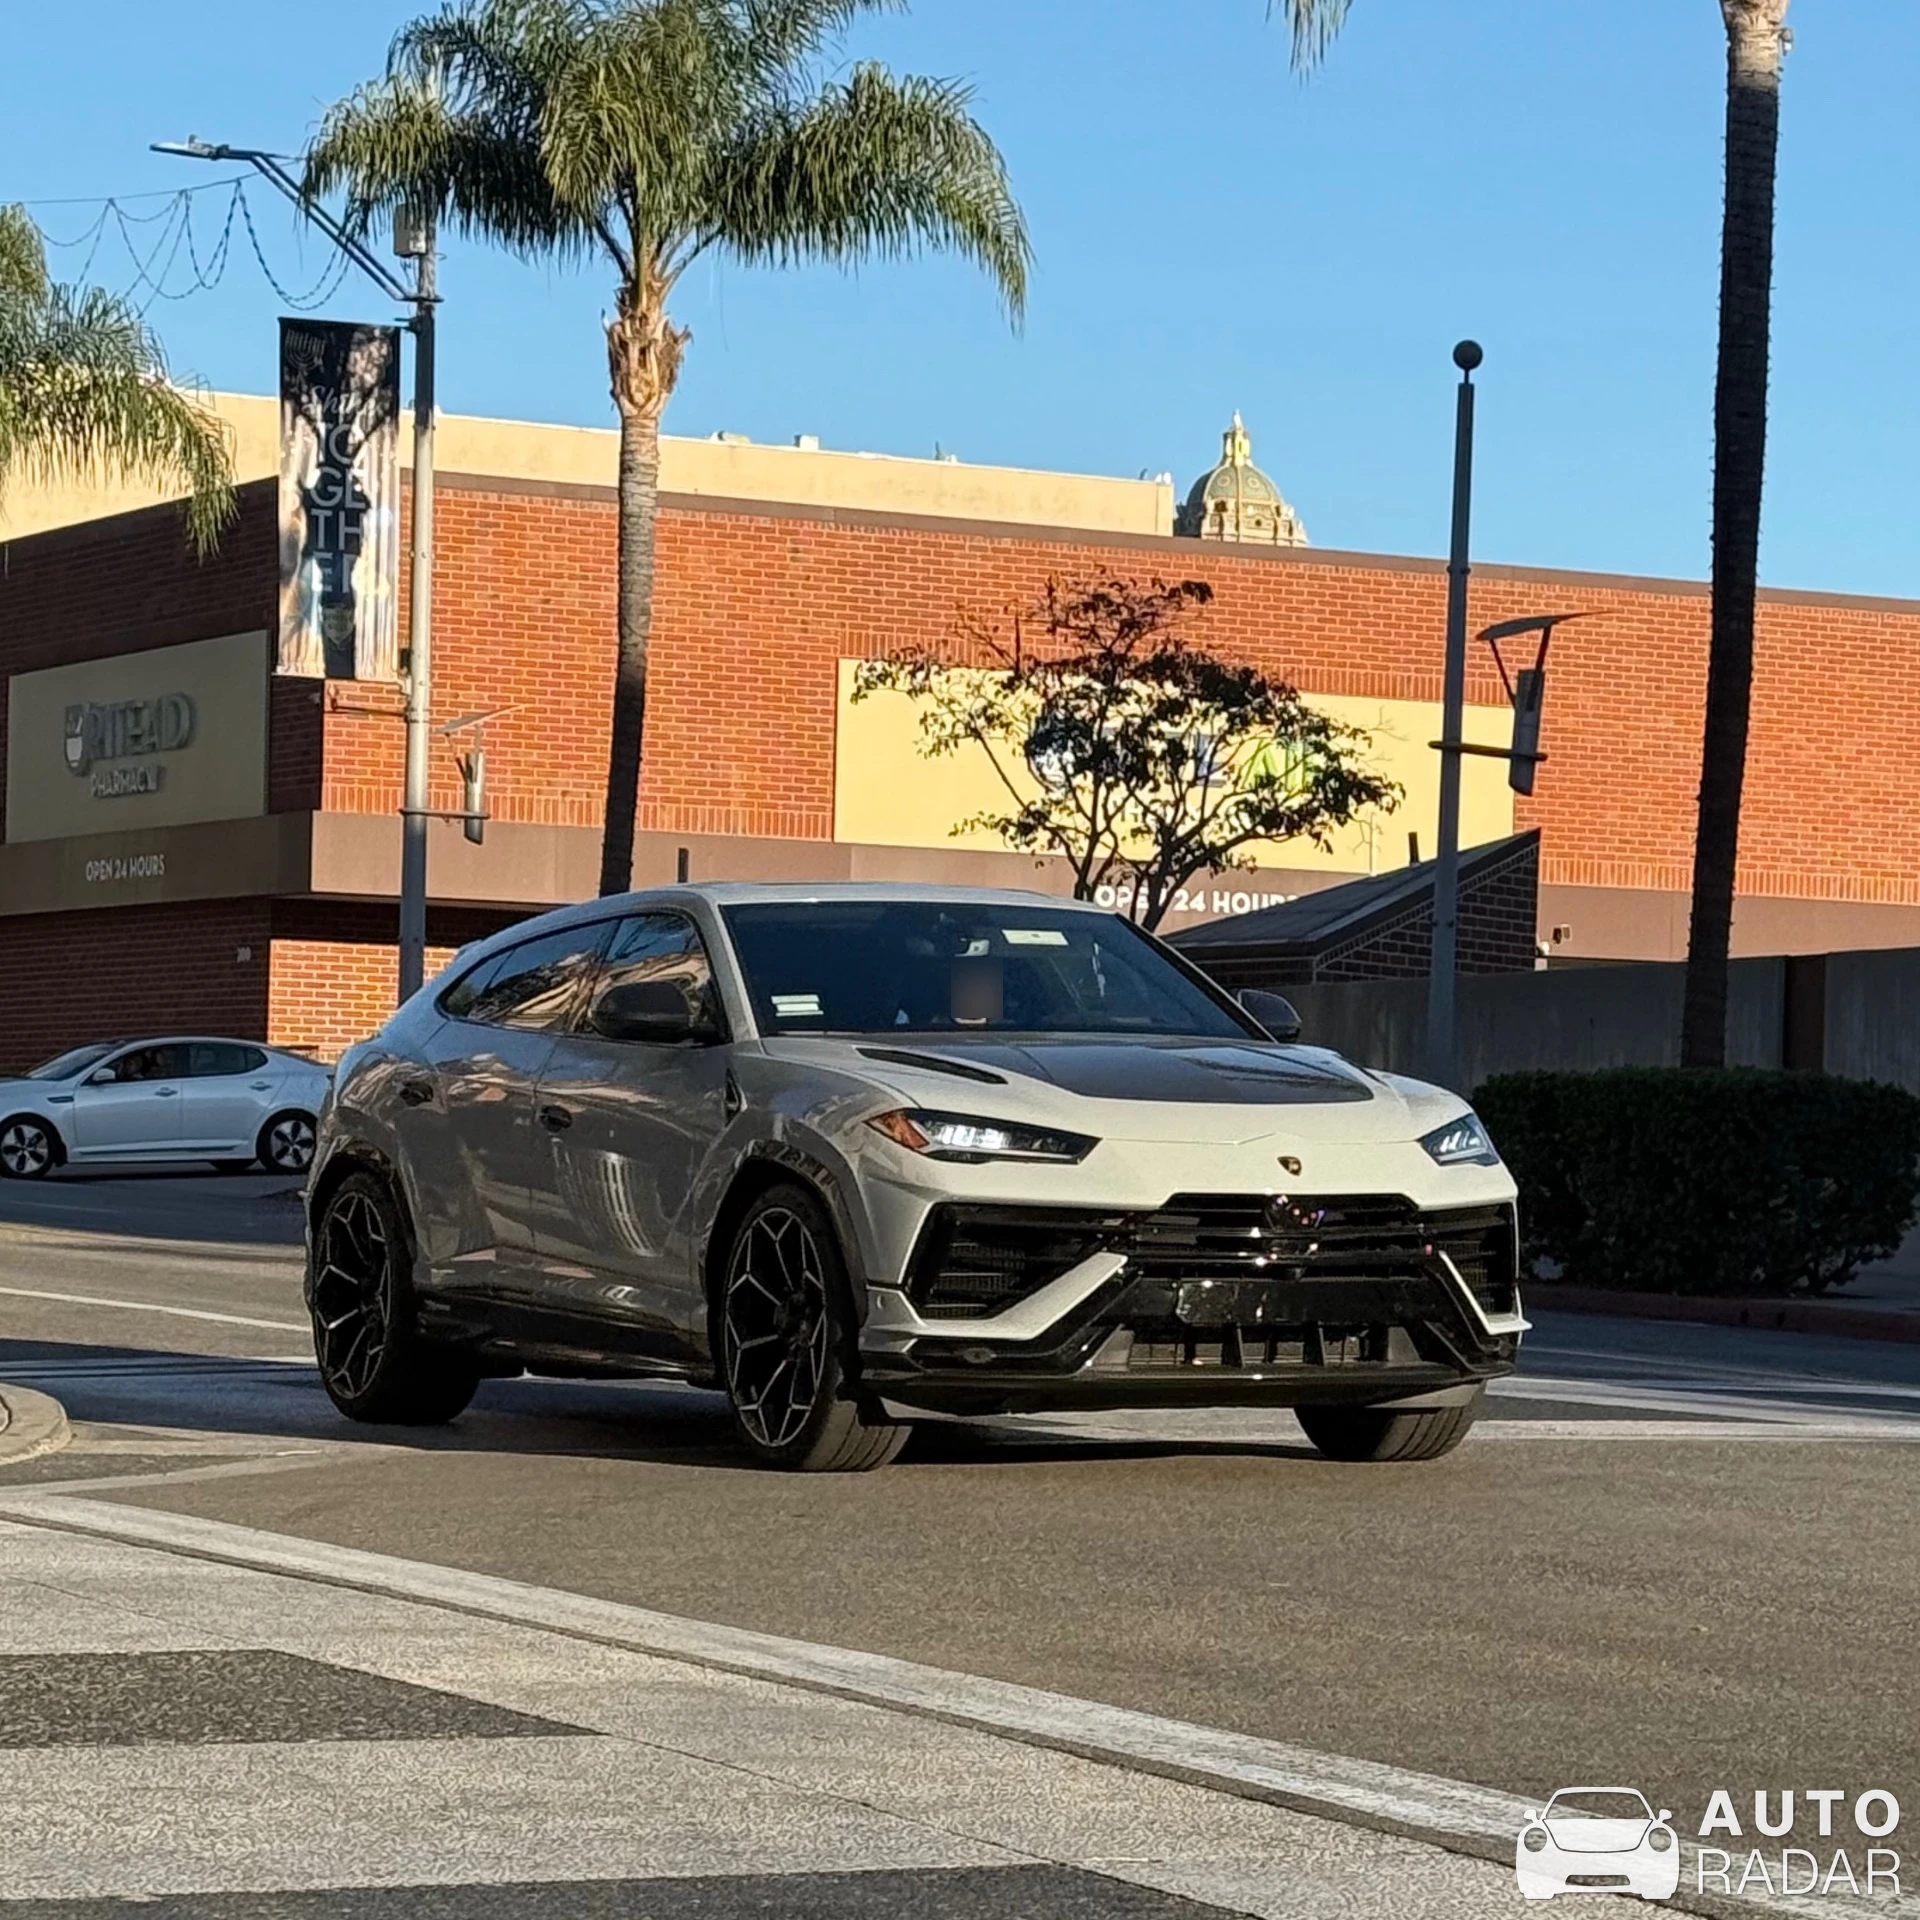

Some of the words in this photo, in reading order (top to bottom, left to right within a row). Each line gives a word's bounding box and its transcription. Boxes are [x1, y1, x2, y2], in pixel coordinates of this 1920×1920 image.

[86, 859, 113, 882] OPEN
[114, 858, 127, 879] 24
[129, 854, 165, 878] HOURS
[1173, 889, 1206, 912] 24
